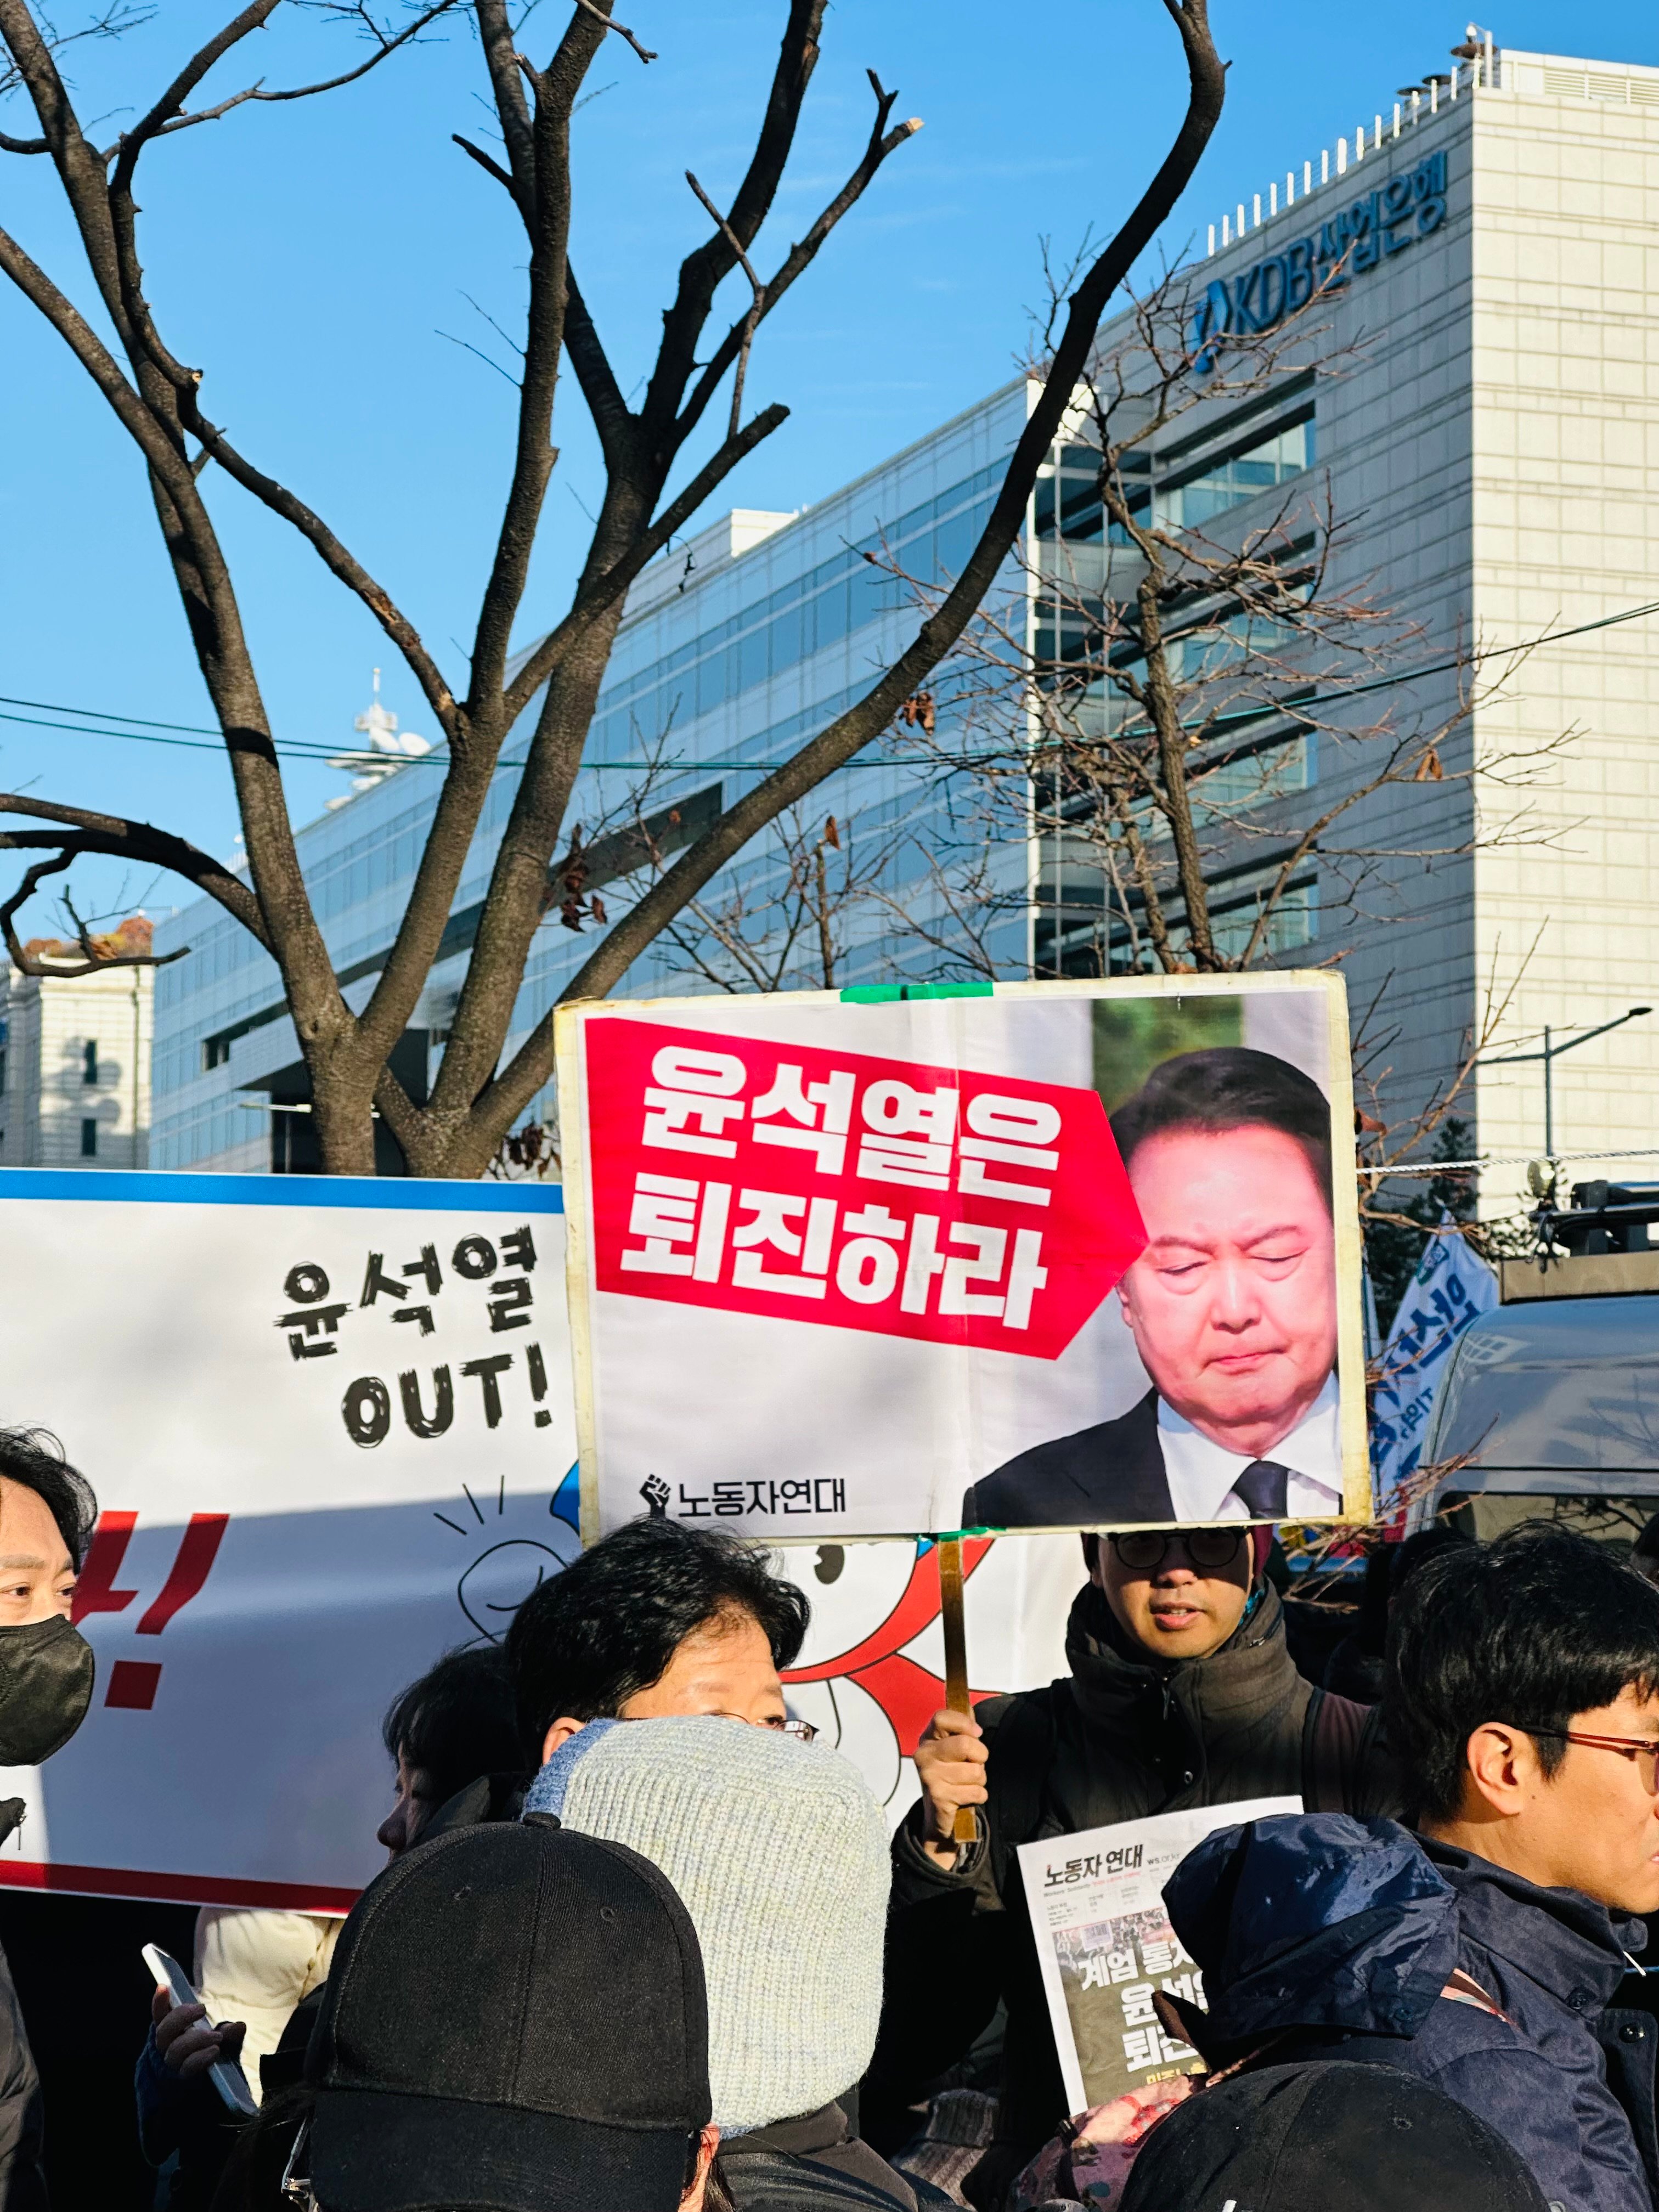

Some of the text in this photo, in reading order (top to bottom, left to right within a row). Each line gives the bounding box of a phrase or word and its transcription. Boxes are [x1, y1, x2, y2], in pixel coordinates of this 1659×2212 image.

[642, 1045, 1061, 1208] 윤석열은
[274, 1224, 537, 1362] 윤석열
[620, 1172, 1048, 1331] 퇴진하라
[341, 1342, 552, 1449] OUT!
[679, 1477, 846, 1517] 노동자연대
[1044, 1854, 1103, 1888] 노동자
[1105, 1844, 1143, 1874] 연대
[1077, 1948, 1139, 1991] 계엄
